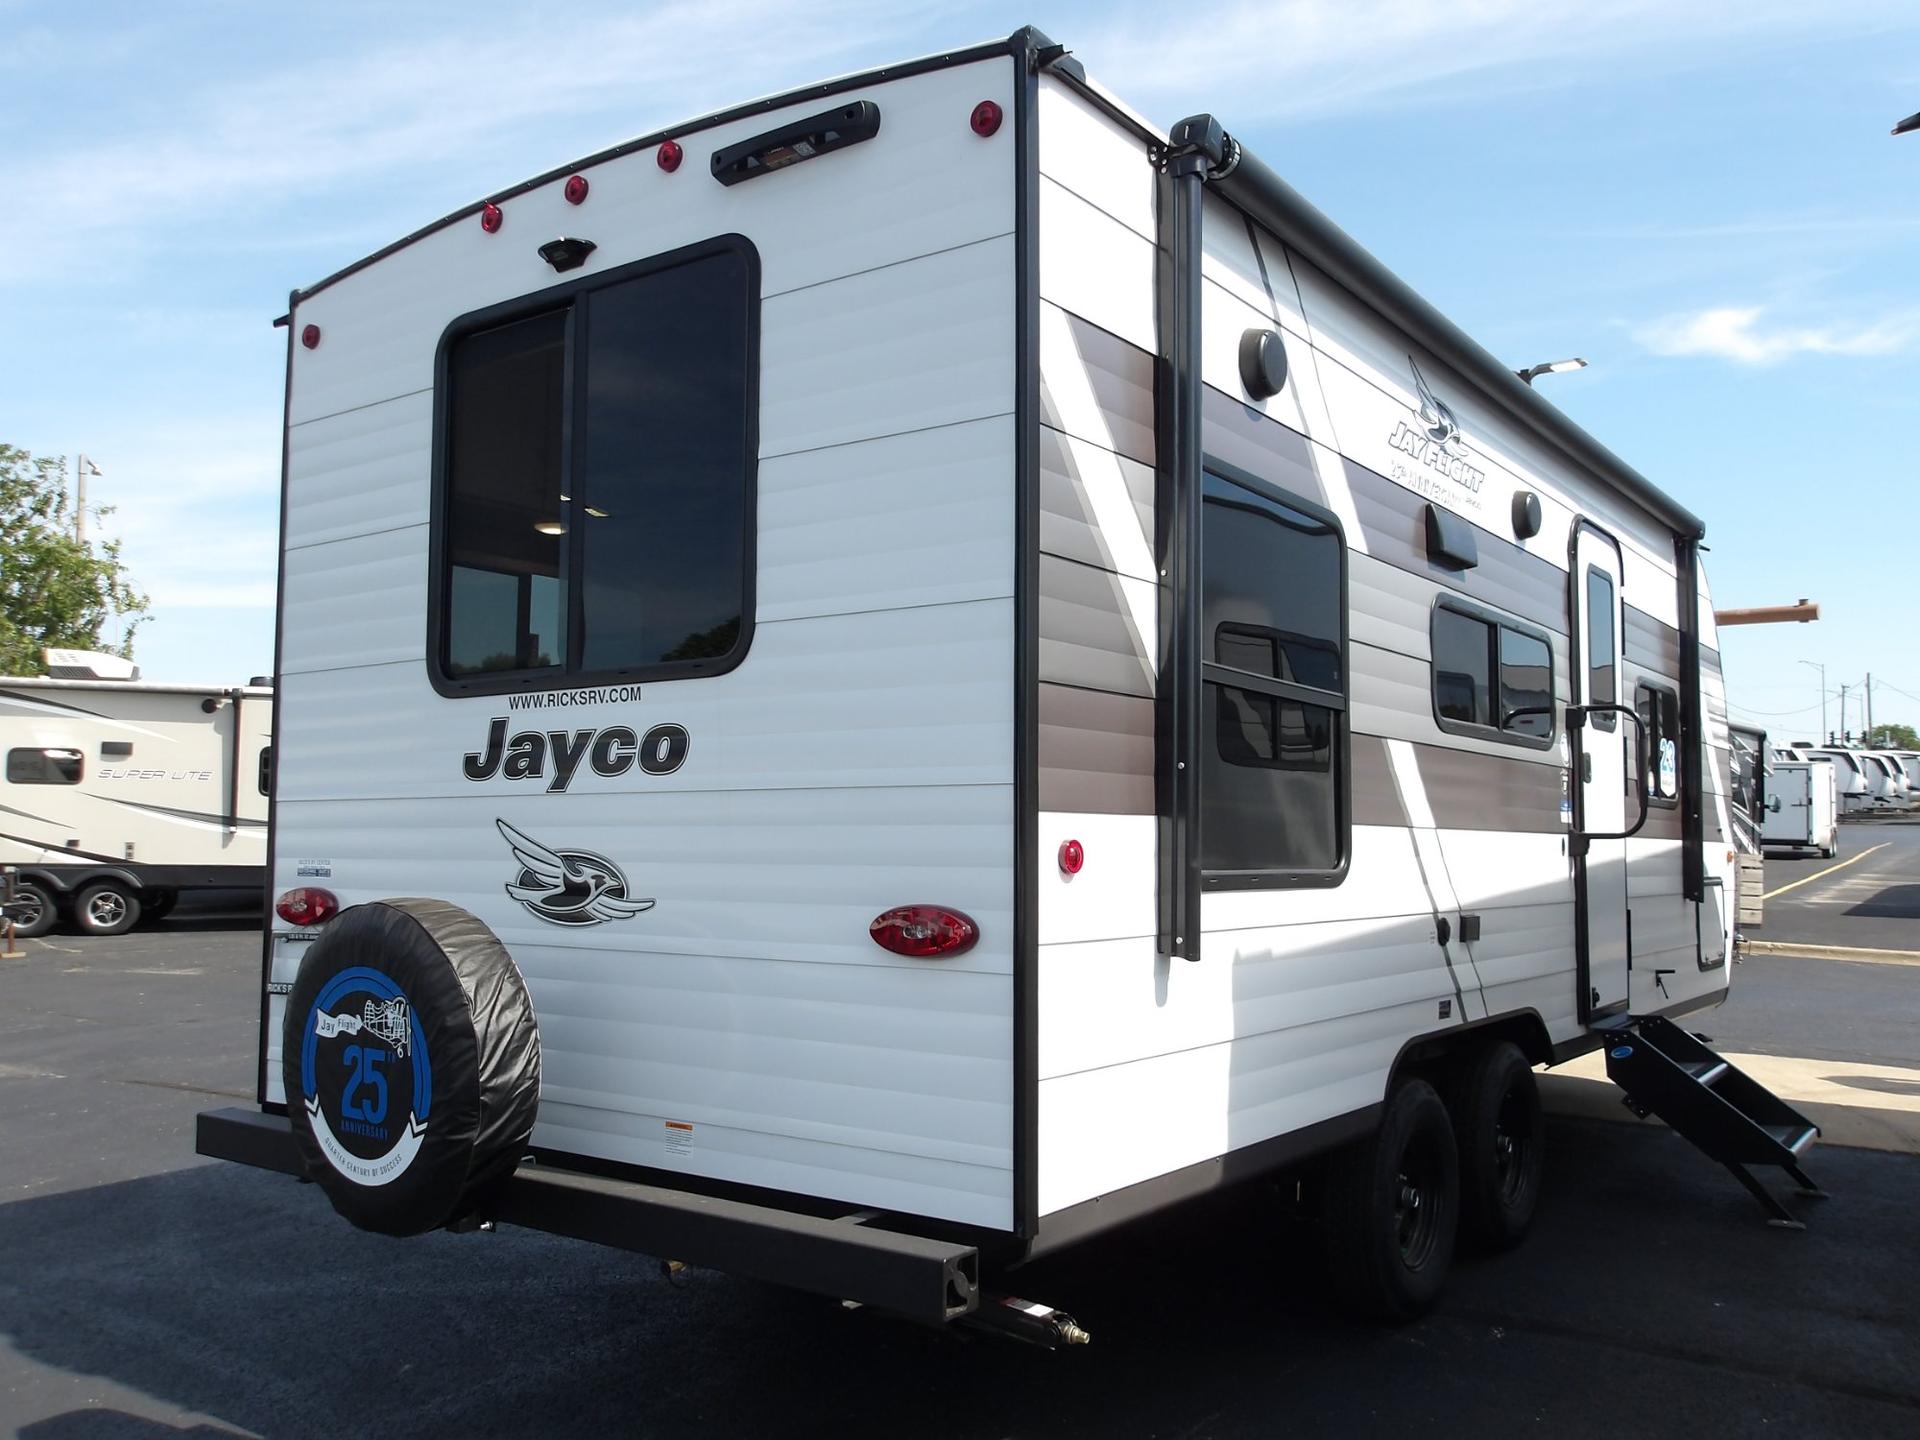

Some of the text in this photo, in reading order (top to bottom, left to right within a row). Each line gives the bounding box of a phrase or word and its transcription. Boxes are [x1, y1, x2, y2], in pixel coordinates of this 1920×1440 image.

[508, 686, 642, 710] WWW.RICKSRV.COM
[462, 716, 691, 793] Jayco
[98, 769, 213, 781] SUPER LITE
[320, 1018, 357, 1033] Jay Flight
[341, 1119, 389, 1140] ANNIVERSARY
[324, 1136, 404, 1177] QUARTER CENTURY OF SUCCESS
